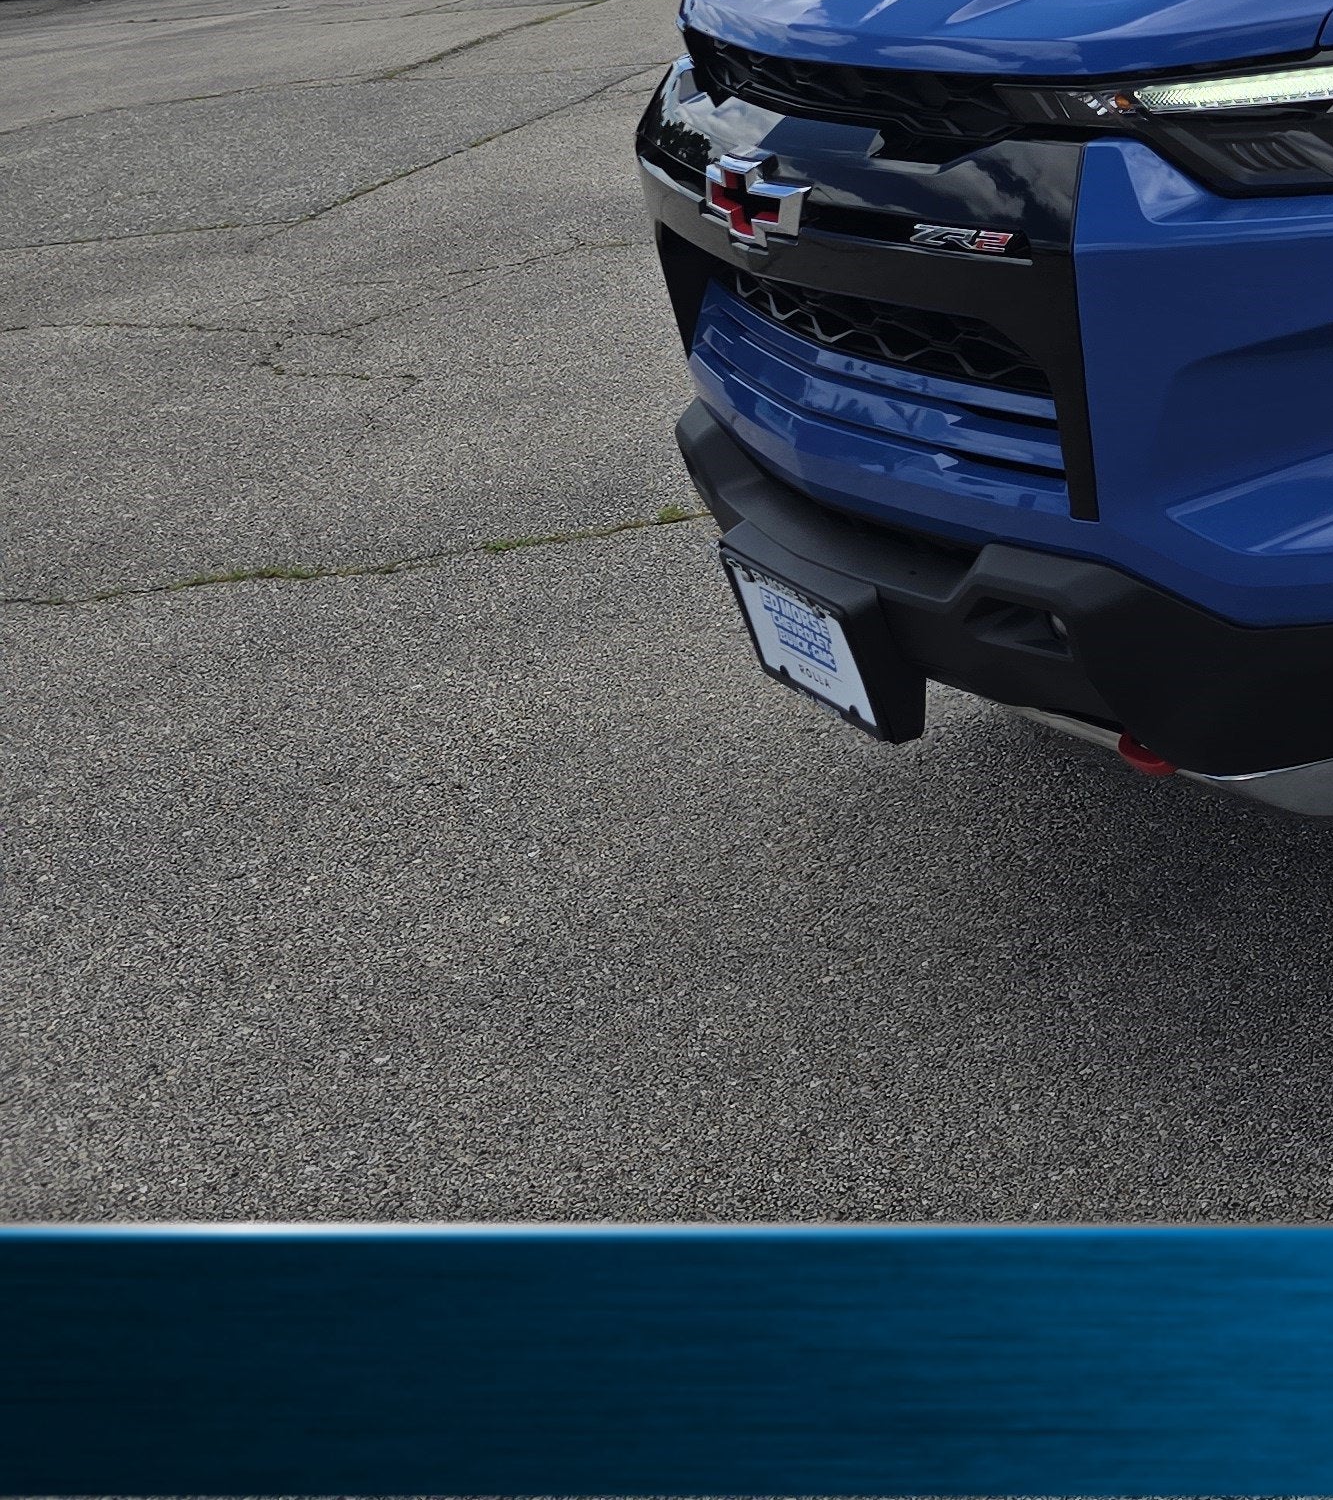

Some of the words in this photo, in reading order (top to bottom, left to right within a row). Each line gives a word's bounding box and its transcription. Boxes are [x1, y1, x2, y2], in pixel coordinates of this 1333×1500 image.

[909, 223, 1014, 253] ZR2
[760, 587, 782, 614] ED
[777, 596, 832, 644] MORSE
[771, 611, 832, 653] CHEVROLET
[798, 663, 832, 689] ROLLA
